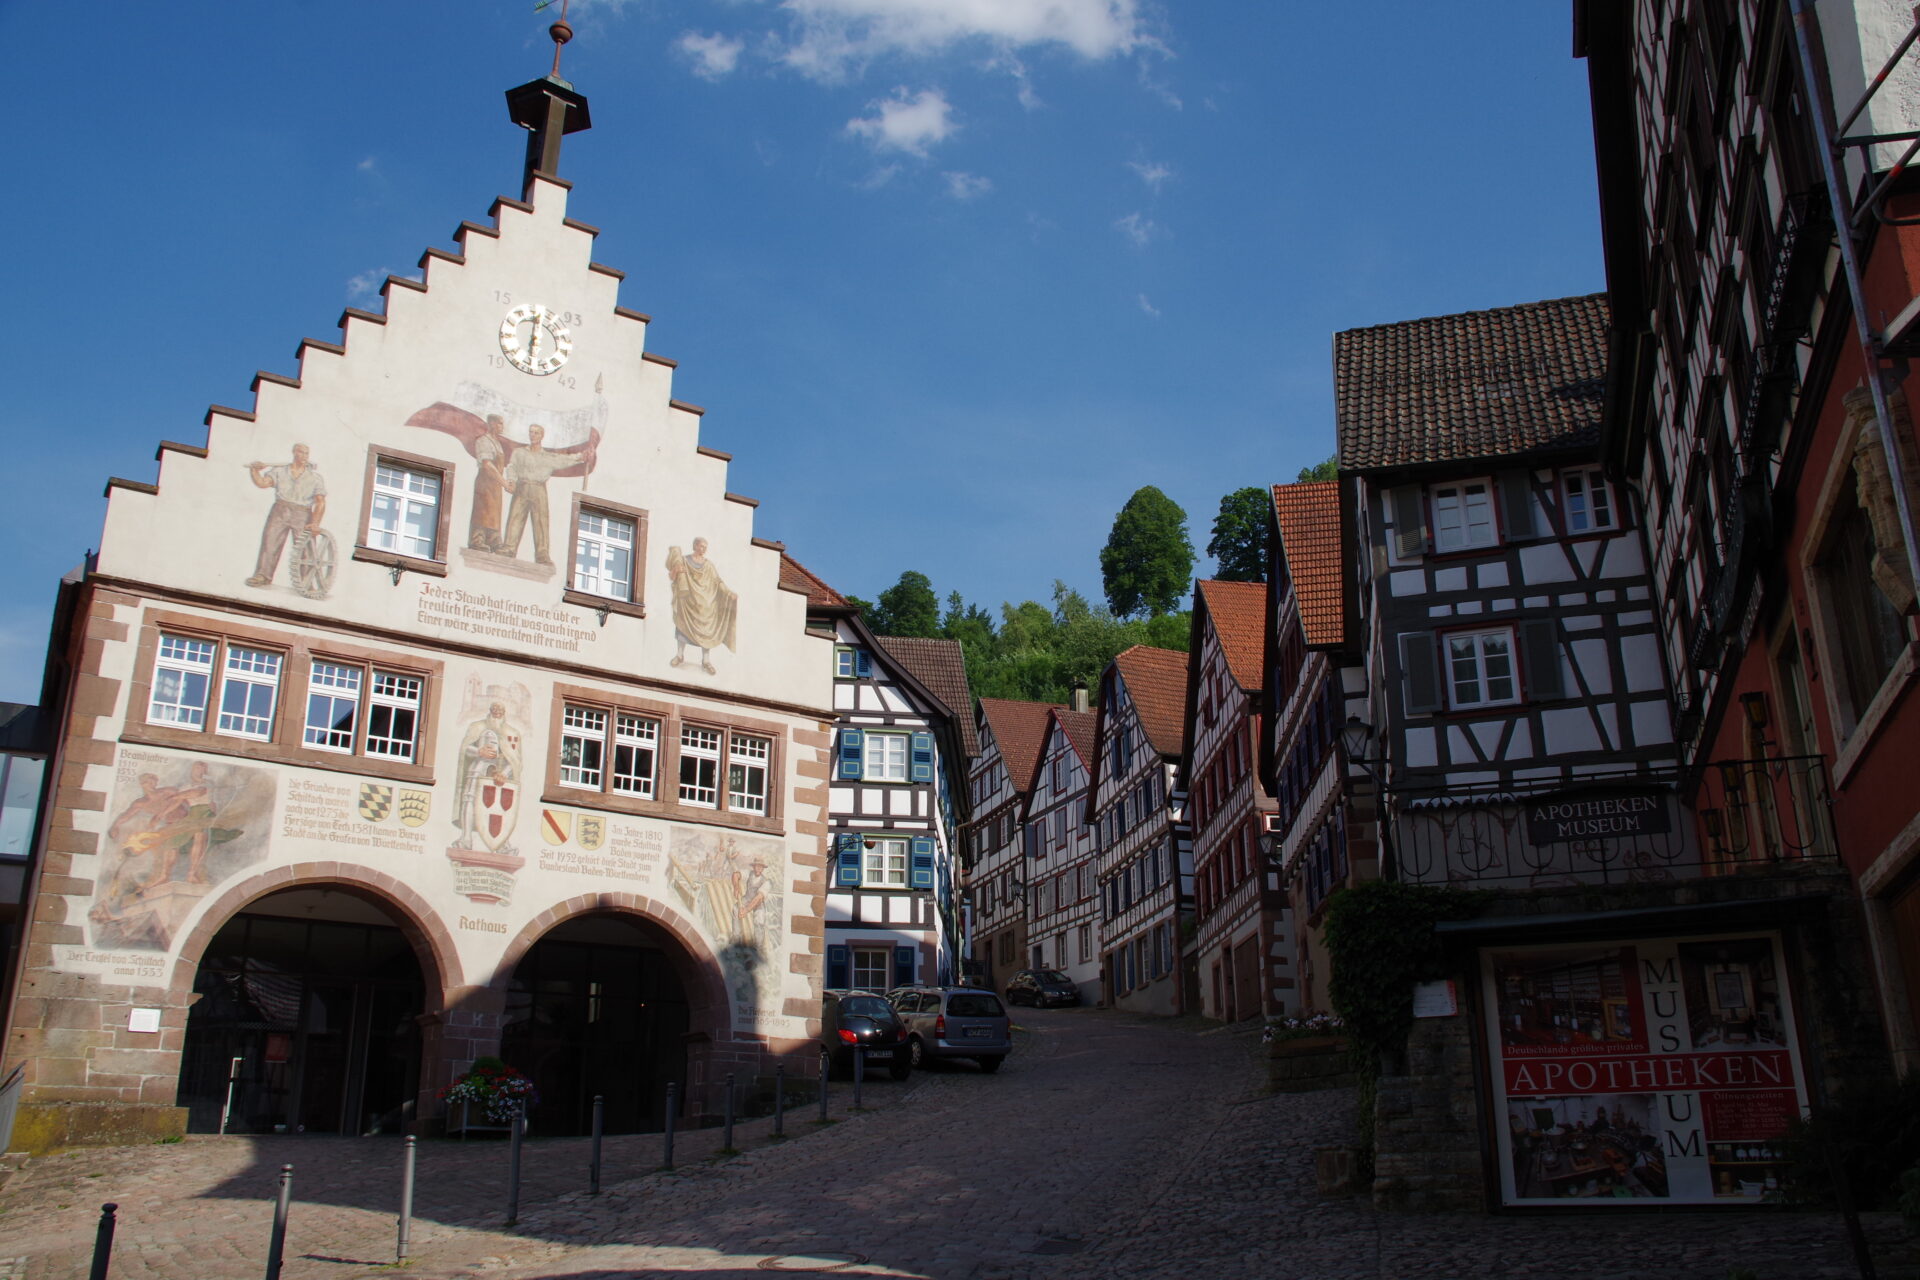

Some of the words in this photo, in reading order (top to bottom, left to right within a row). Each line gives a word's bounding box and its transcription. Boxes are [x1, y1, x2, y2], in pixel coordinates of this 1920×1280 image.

[494, 290, 511, 304] 15
[563, 311, 583, 326] 93
[487, 354, 505, 369] 19
[558, 374, 576, 390] 42
[455, 589, 490, 606] Stand
[571, 615, 580, 625] er
[417, 611, 443, 626] Einer
[471, 622, 484, 634] zu
[485, 625, 532, 644] verachten
[419, 597, 461, 615] treulich
[521, 617, 542, 631] was
[543, 621, 565, 635] auch
[566, 625, 597, 642] irgend
[1533, 795, 1657, 822] APOTHEKEN
[645, 830, 663, 841] 1810
[1557, 815, 1641, 837] MUSEUM
[459, 915, 508, 934] Rathaus
[1507, 1044, 1568, 1055] Deutschlands
[1607, 1042, 1644, 1054] privates
[1512, 1054, 1782, 1091] APOTHEKEN
